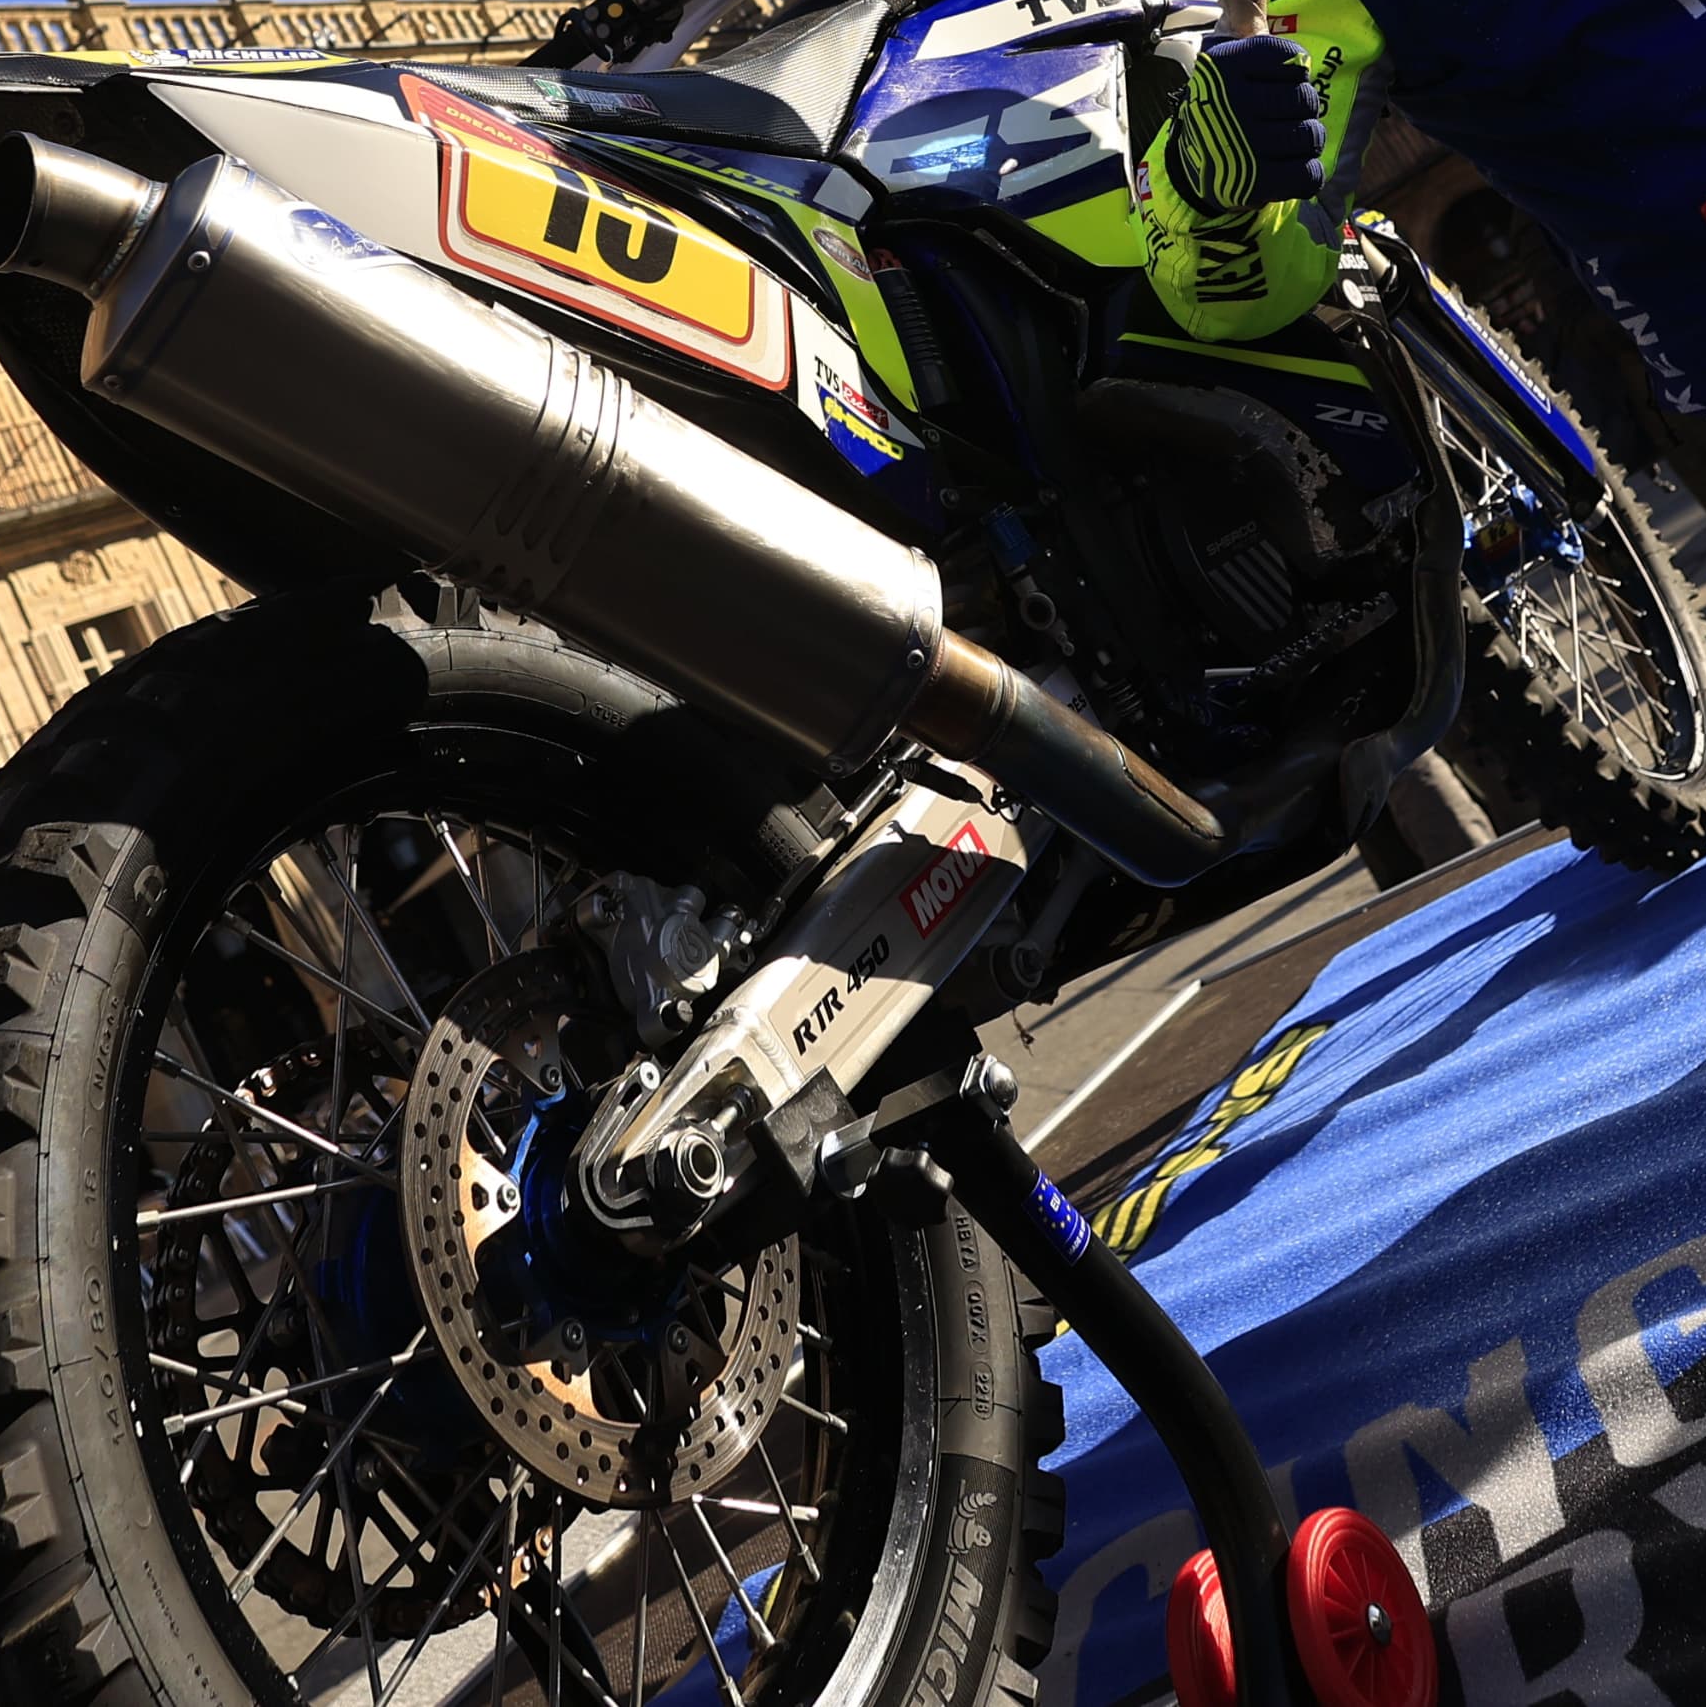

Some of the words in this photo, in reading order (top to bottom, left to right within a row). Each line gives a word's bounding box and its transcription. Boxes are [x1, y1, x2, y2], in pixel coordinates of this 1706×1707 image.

[188, 47, 322, 63] MICHELIN
[813, 355, 841, 394] TVS
[842, 380, 889, 428] Racing
[1313, 401, 1391, 433] ZR
[823, 395, 905, 462] SHERCO
[907, 831, 989, 926] MOTUL
[791, 990, 846, 1057] RTR
[845, 933, 892, 998] 450
[1049, 1191, 1062, 1213] EU
[84, 1273, 127, 1447] 140/80
